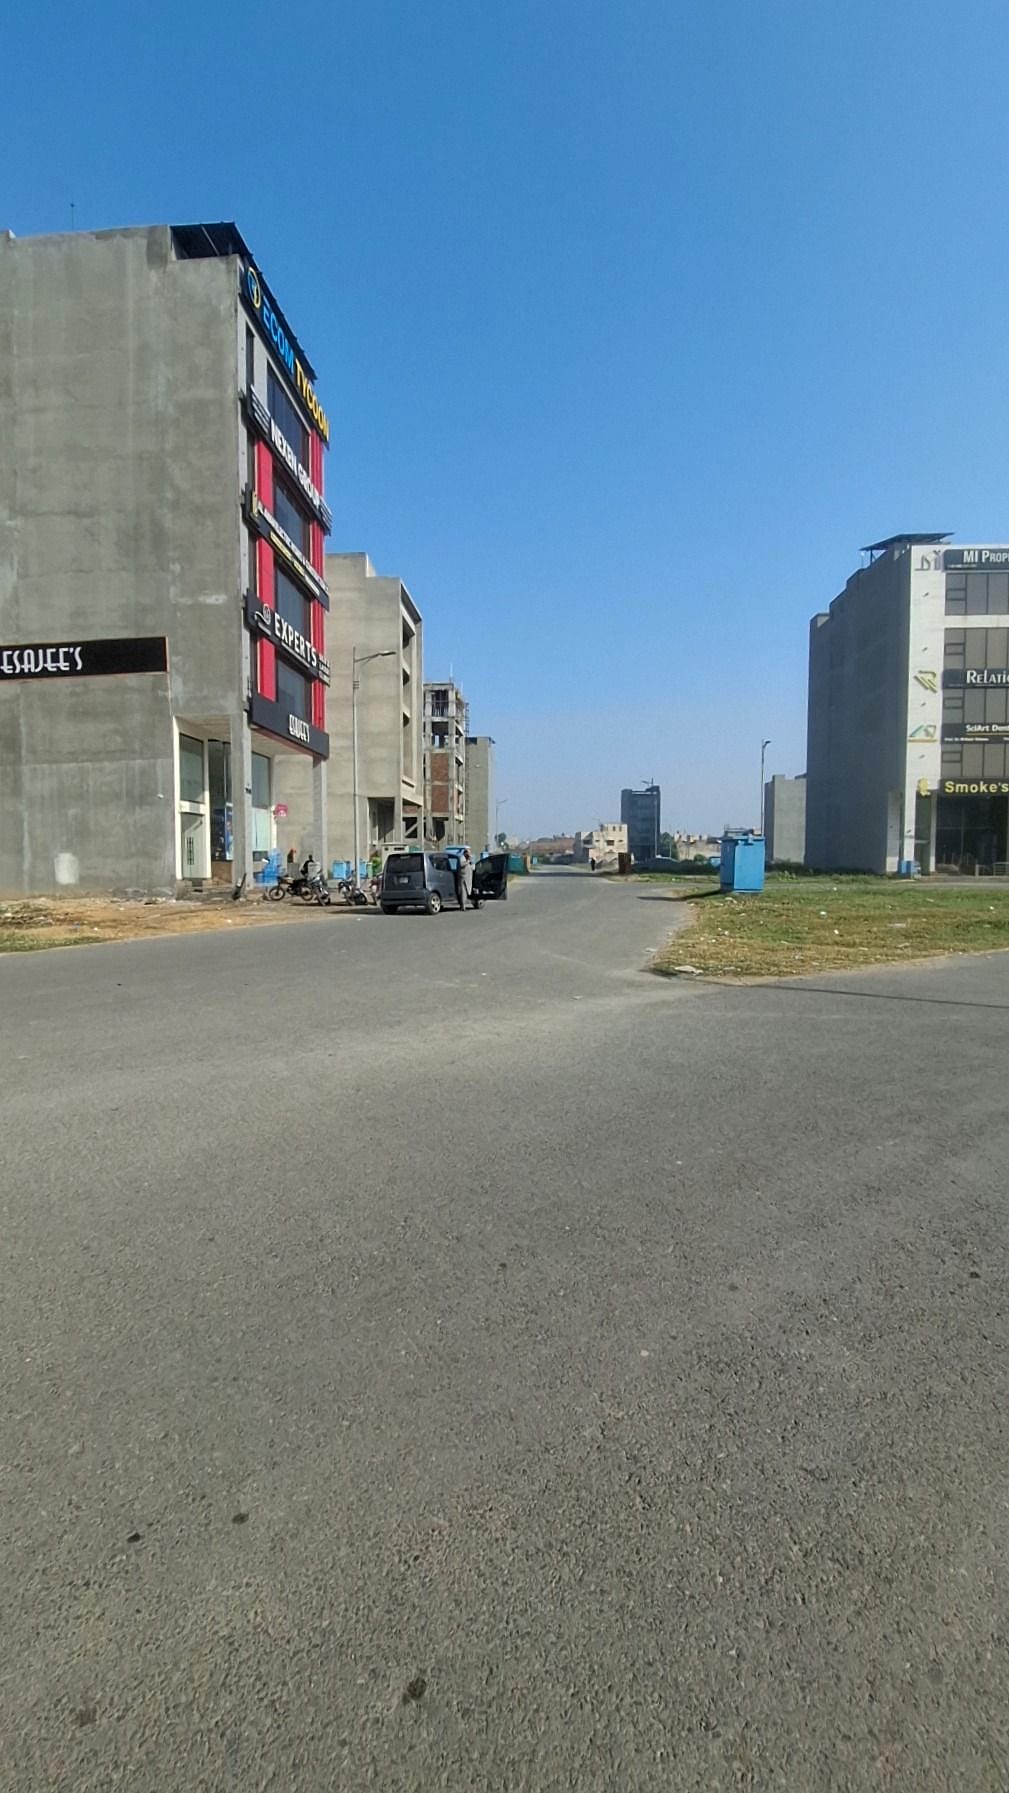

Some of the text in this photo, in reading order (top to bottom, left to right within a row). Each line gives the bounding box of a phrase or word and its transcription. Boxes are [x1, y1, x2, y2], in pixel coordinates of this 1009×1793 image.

[262, 297, 329, 441] ECOM TYCOON
[963, 550, 978, 562] MI
[274, 612, 317, 667] EXPERTS
[0, 647, 82, 673] ESAJEE'S
[945, 781, 1009, 793] Smoke's
